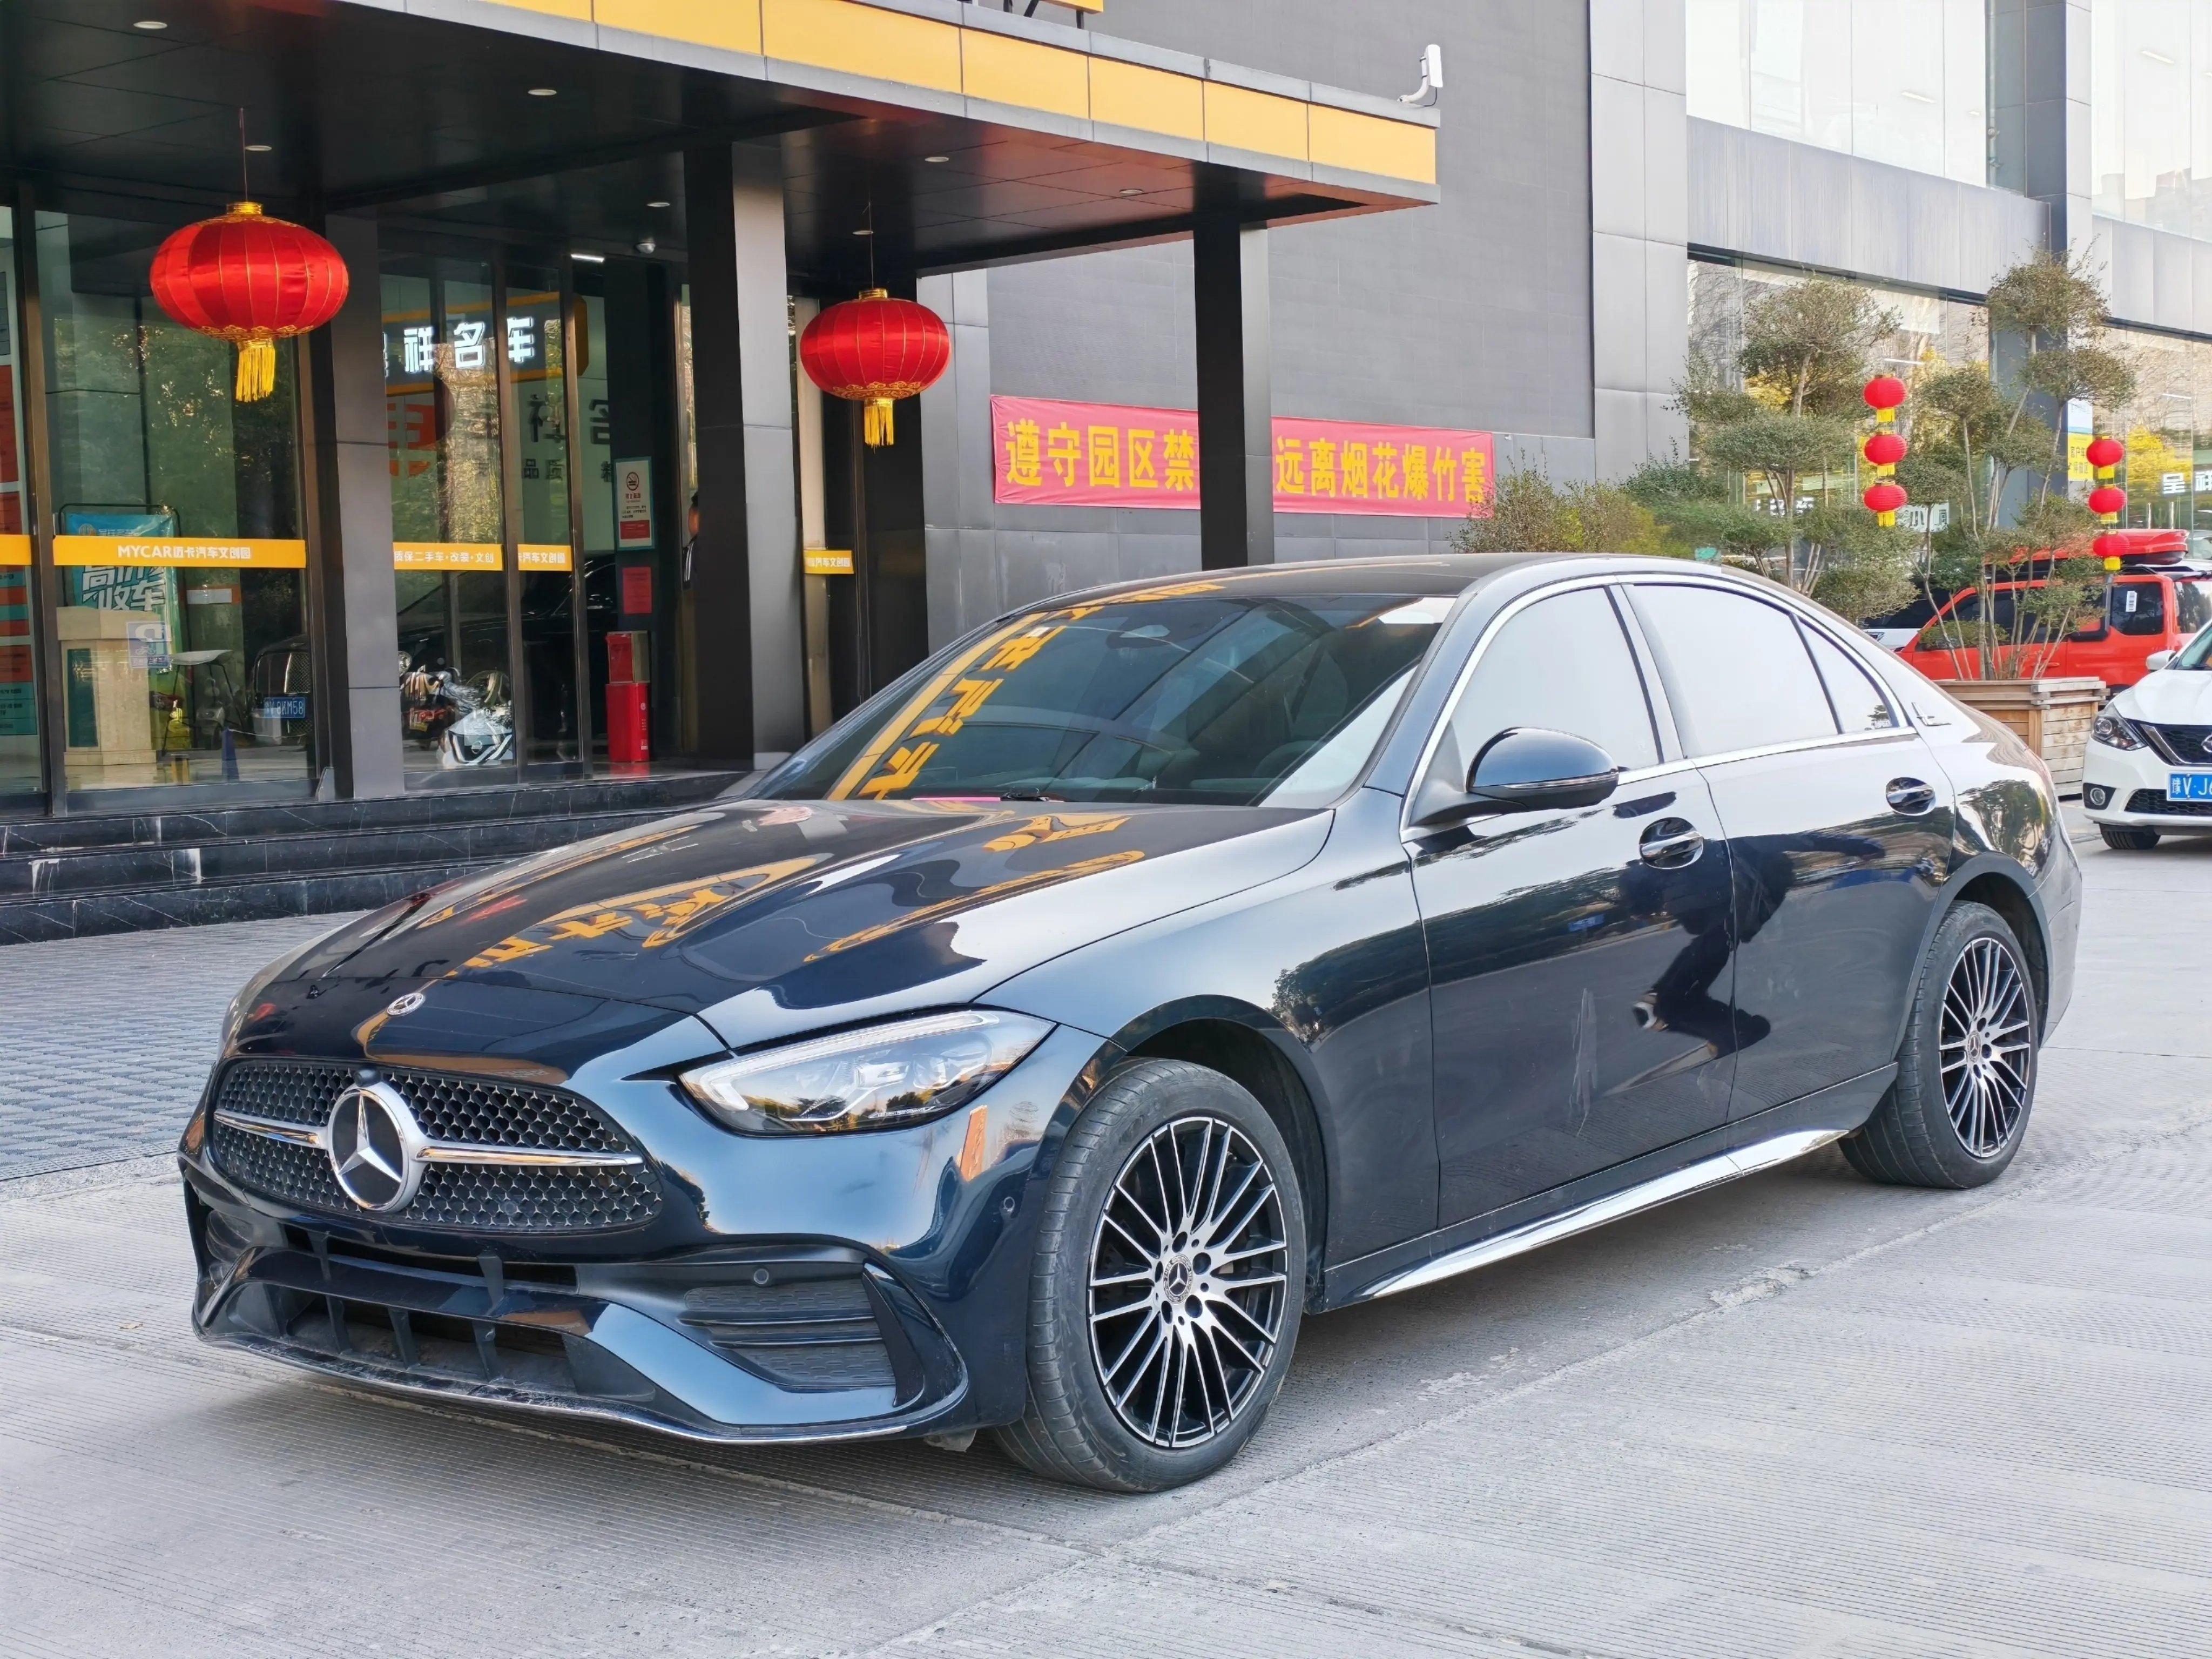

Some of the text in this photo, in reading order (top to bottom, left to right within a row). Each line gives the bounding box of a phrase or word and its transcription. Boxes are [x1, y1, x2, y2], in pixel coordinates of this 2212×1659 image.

[383, 316, 535, 377] 祥名车
[1006, 419, 1486, 503] 遵守园区禁 远离烟花爆竹害
